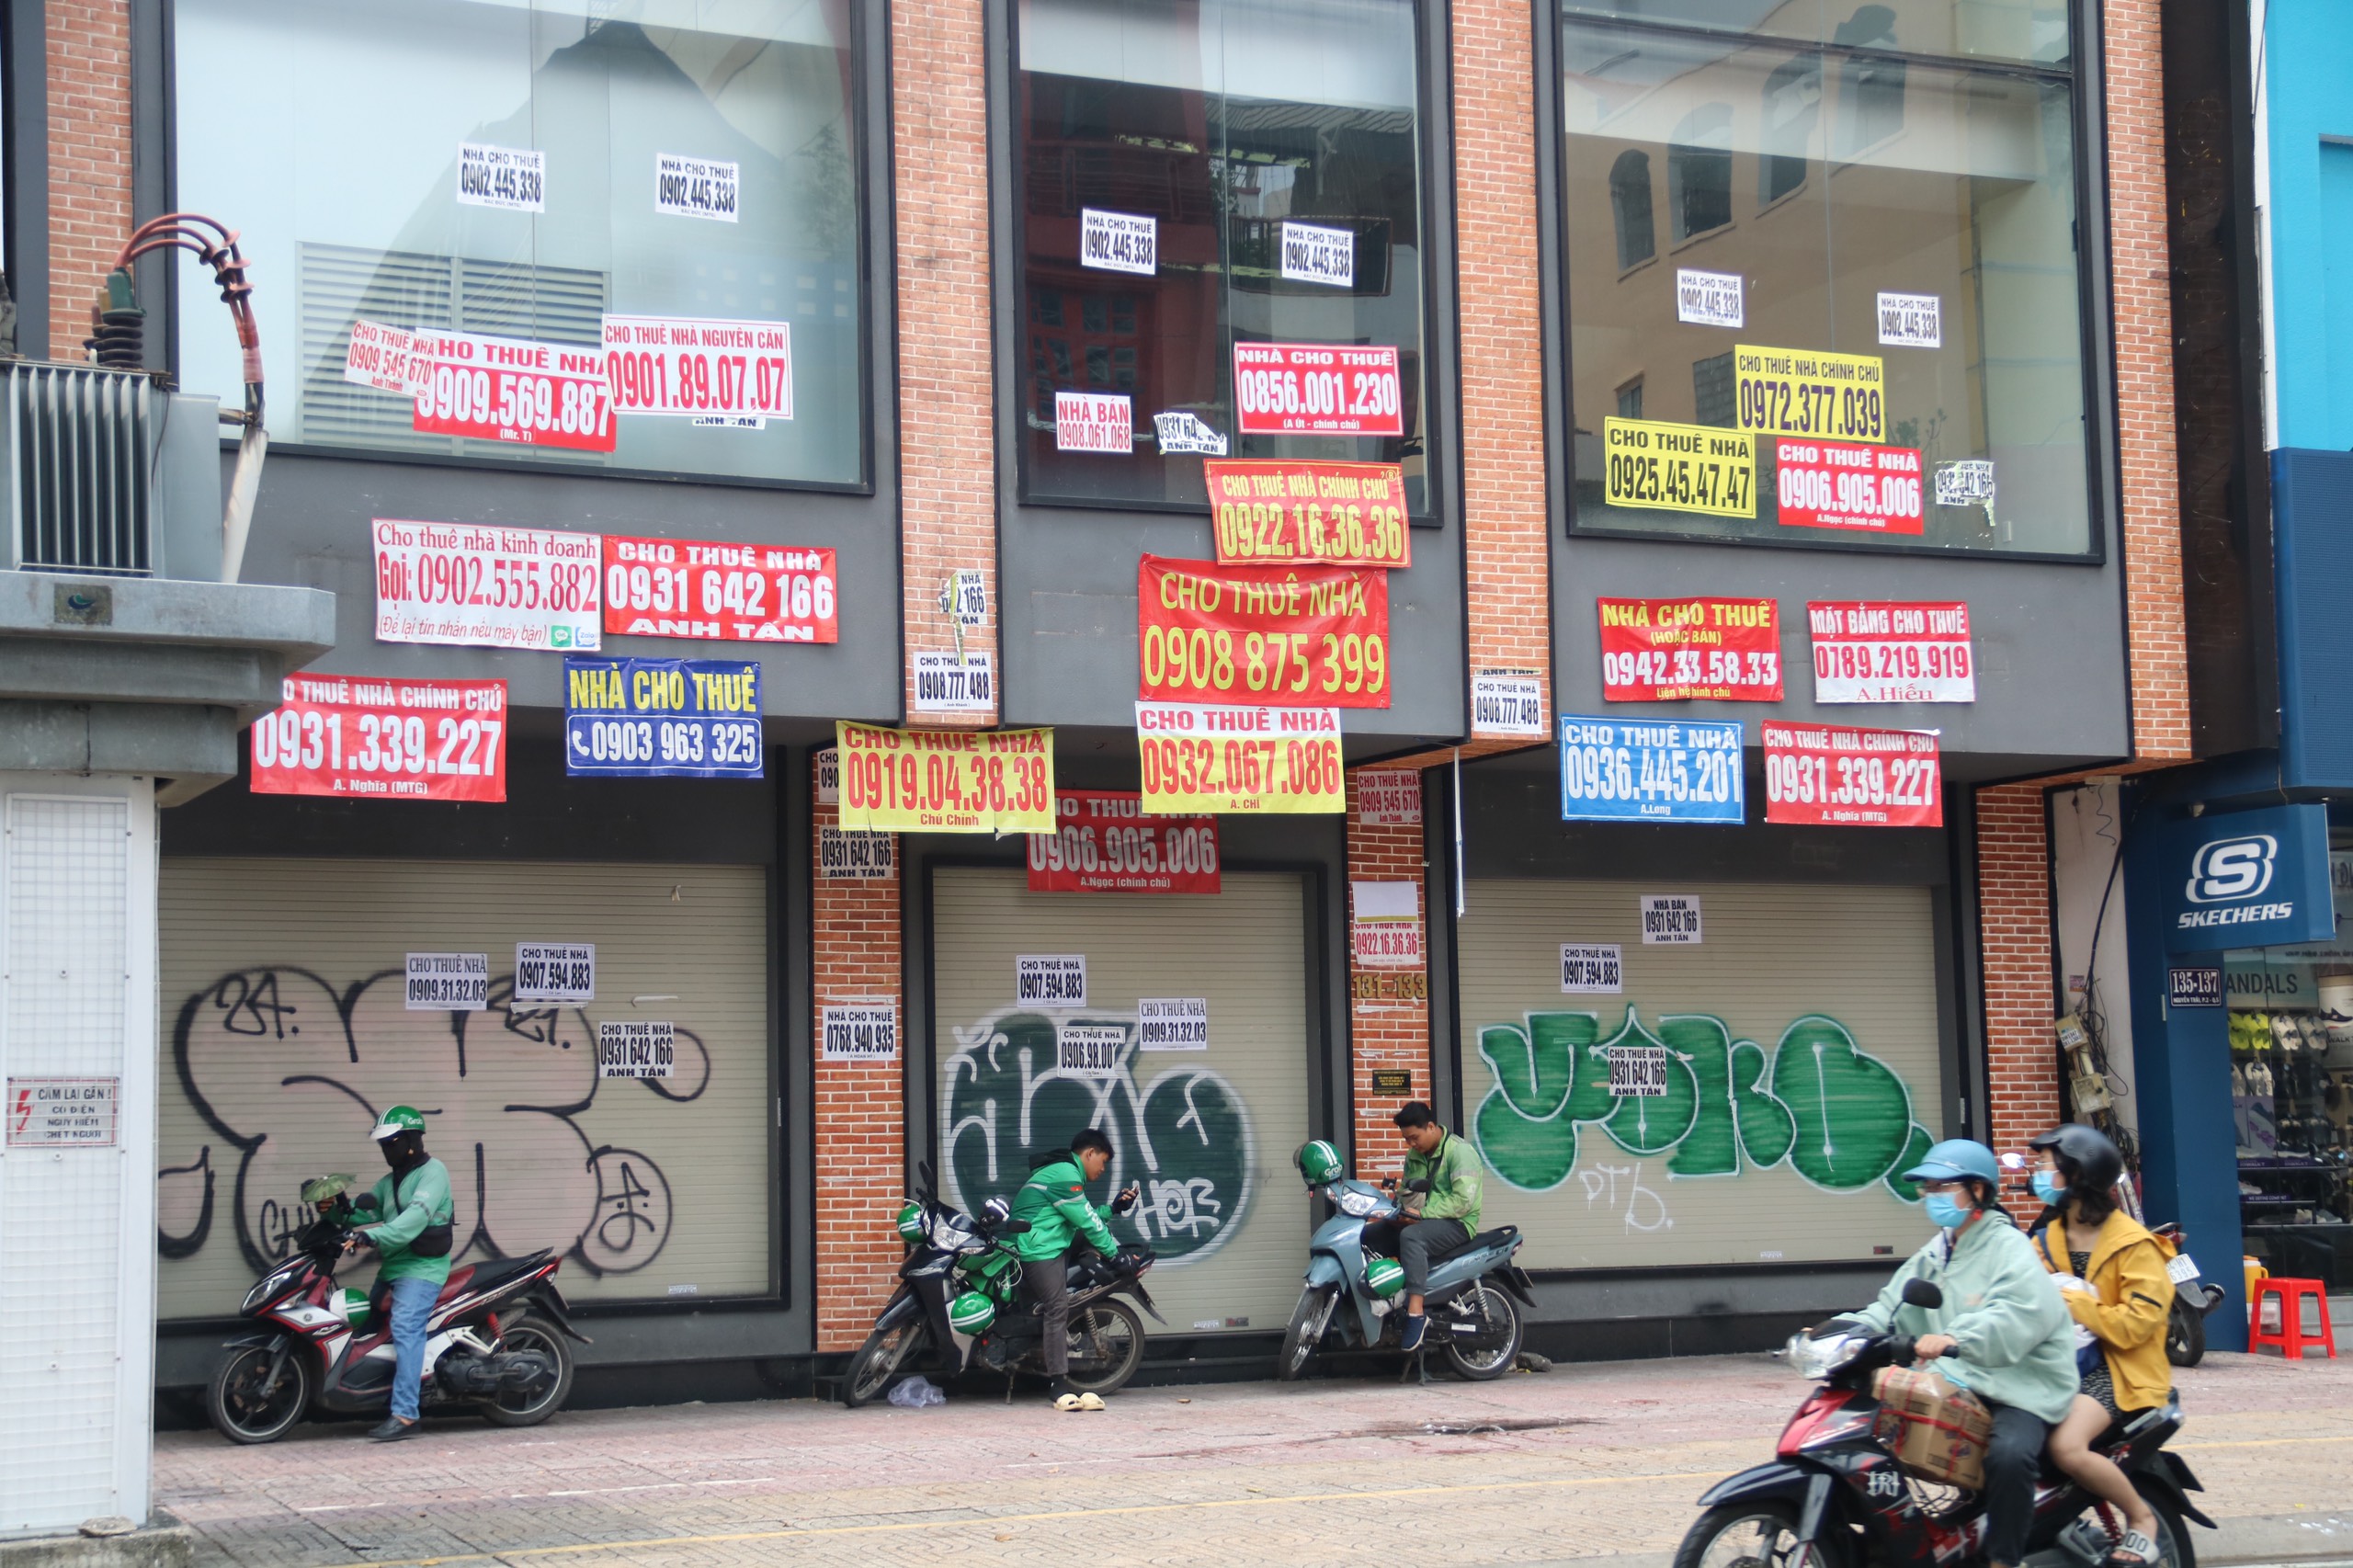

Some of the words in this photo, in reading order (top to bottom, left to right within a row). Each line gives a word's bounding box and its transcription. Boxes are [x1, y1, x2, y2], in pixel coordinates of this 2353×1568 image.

[461, 163, 541, 203] 0902.445.338
[660, 173, 735, 213] 0902.445.338
[1086, 228, 1153, 265] 0902.445.338
[1286, 241, 1349, 278] 0902.445.338
[606, 325, 631, 344] CHO
[634, 324, 667, 345] THUÊ
[671, 325, 698, 346] NHÀ
[702, 328, 753, 348] NGUYÊN
[757, 329, 783, 349] CĂN
[349, 342, 381, 373] 0909
[383, 350, 404, 379] 545
[409, 358, 432, 385] 670
[1238, 347, 1284, 363] NHÀ
[1290, 351, 1333, 364] CHO
[1340, 352, 1393, 366] THUÊ
[608, 350, 785, 411] 0901.89.07.07
[1241, 369, 1397, 415] 0856.001.230
[1741, 379, 1881, 437] 0972.377.039
[1059, 422, 1131, 449] 0908.061.068
[1313, 419, 1338, 428] chính
[1340, 419, 1360, 430] chủ)
[1611, 453, 1750, 509] 0925.45.47.47
[1779, 467, 1919, 517] 0906.905.006
[1221, 502, 1402, 559] 0922.16.36.36
[1845, 515, 1868, 526] (chính
[378, 524, 413, 547] Cho
[419, 528, 458, 550] thuê
[464, 529, 495, 551] nhà
[502, 531, 539, 555] kinh
[544, 536, 596, 559] doanh
[379, 551, 412, 610] Gọi:
[418, 553, 597, 612] 0902.555.882
[608, 564, 688, 612] 0931
[702, 570, 765, 616] 642
[776, 574, 834, 619] 166
[1161, 573, 1221, 612] CHO
[1226, 572, 1301, 616] THUÊ
[1309, 572, 1368, 616] NHÀ
[402, 617, 415, 640] lại
[471, 617, 492, 638] nếu
[494, 622, 517, 642] máy
[522, 625, 547, 645] bận)
[627, 618, 720, 636] ANH
[1810, 607, 1843, 639] MẶT
[1893, 610, 1924, 634] CHO
[1928, 605, 1965, 634] THUÊ
[1651, 630, 1688, 646] (HOẶC
[1692, 629, 1722, 646] BÁN)
[1143, 625, 1234, 689] 0908
[1246, 632, 1309, 692] 875
[1323, 632, 1384, 693] 399
[1604, 651, 1778, 686] 0942.33.58.33
[1815, 645, 1969, 678] 0789.219.919
[570, 662, 626, 710] NHÀ
[633, 670, 685, 710] CHO
[692, 666, 756, 711] THUÊ
[919, 671, 989, 700] 0908.777.488
[1691, 687, 1711, 697] hính
[1857, 683, 1934, 700] A.Hiếu
[1140, 710, 1193, 730] CHO
[1203, 708, 1270, 731] THUÊ
[1280, 708, 1336, 732] NHÀ
[1476, 697, 1539, 725] 0908.777.488
[256, 710, 501, 776] 0931.339.227
[592, 722, 653, 761] 0903
[661, 722, 703, 762] 963
[711, 723, 756, 763] 325
[846, 728, 901, 749] CHO
[987, 730, 1045, 754] NHÀ
[1565, 724, 1614, 744] CHO
[1620, 724, 1680, 747] THUÊ
[1688, 726, 1737, 750] NHÀ
[1142, 739, 1339, 794] 0932.067.086
[1358, 776, 1375, 787] CHO
[1378, 772, 1397, 787] THUÊ
[1401, 771, 1417, 786] NHÀ
[1567, 745, 1740, 802] 0936.445.201
[1767, 754, 1936, 805] 0931.339.227
[333, 779, 347, 790] A.
[349, 779, 388, 794] Nghĩa
[392, 781, 427, 794] (MTG)
[847, 752, 1048, 812] 0919.04.38.38
[1231, 800, 1239, 809] A.
[1360, 791, 1381, 812] 0909
[1384, 790, 1400, 811] 545
[1403, 790, 1419, 811] 670
[1641, 804, 1671, 816] A.Long
[921, 813, 943, 825] Chú
[1822, 811, 1831, 820] A.
[1834, 811, 1859, 822] Nghĩa
[1862, 811, 1887, 822] (MTG)
[822, 840, 847, 866] 0931
[851, 840, 870, 866] 642
[873, 840, 892, 866] 166
[1029, 825, 1216, 873] 0906.905.006
[1081, 877, 1114, 889] A.Ngọc
[1117, 877, 1147, 888] (chính
[1150, 878, 1171, 888] chủ)
[1645, 911, 1665, 932] 0931
[1666, 911, 1681, 932] 642
[1683, 910, 1697, 932] 166
[2177, 903, 2293, 928] SKECHERS
[1357, 932, 1417, 955] 0922.16.36.36
[410, 958, 430, 972] CHO
[434, 954, 461, 972] THUÊ
[465, 954, 486, 972] NHÀ
[520, 961, 590, 991] 0907.594.883
[1564, 960, 1618, 985] 0907.594.883
[409, 979, 486, 1002] 0909.31.32.03
[1353, 975, 1381, 998] 131
[1394, 974, 1427, 999] 133
[2173, 971, 2217, 993] 135-137
[2226, 973, 2298, 994] ANDALS
[1142, 1003, 1158, 1017] CHO
[1161, 999, 1185, 1017] THUÊ
[1188, 999, 1206, 1016] NHÀ
[601, 1024, 621, 1035] CHO
[625, 1022, 649, 1035] THUÊ
[653, 1022, 671, 1035] NHÀ
[827, 1024, 893, 1052] 0768.940.935
[1142, 1022, 1206, 1042] 0909.31.32.03
[601, 1037, 627, 1065] 0931
[631, 1037, 651, 1064] 642
[654, 1037, 673, 1065] 166
[1062, 1042, 1116, 1069] 0906.98.00
[1324, 1164, 1342, 1176] Grab
